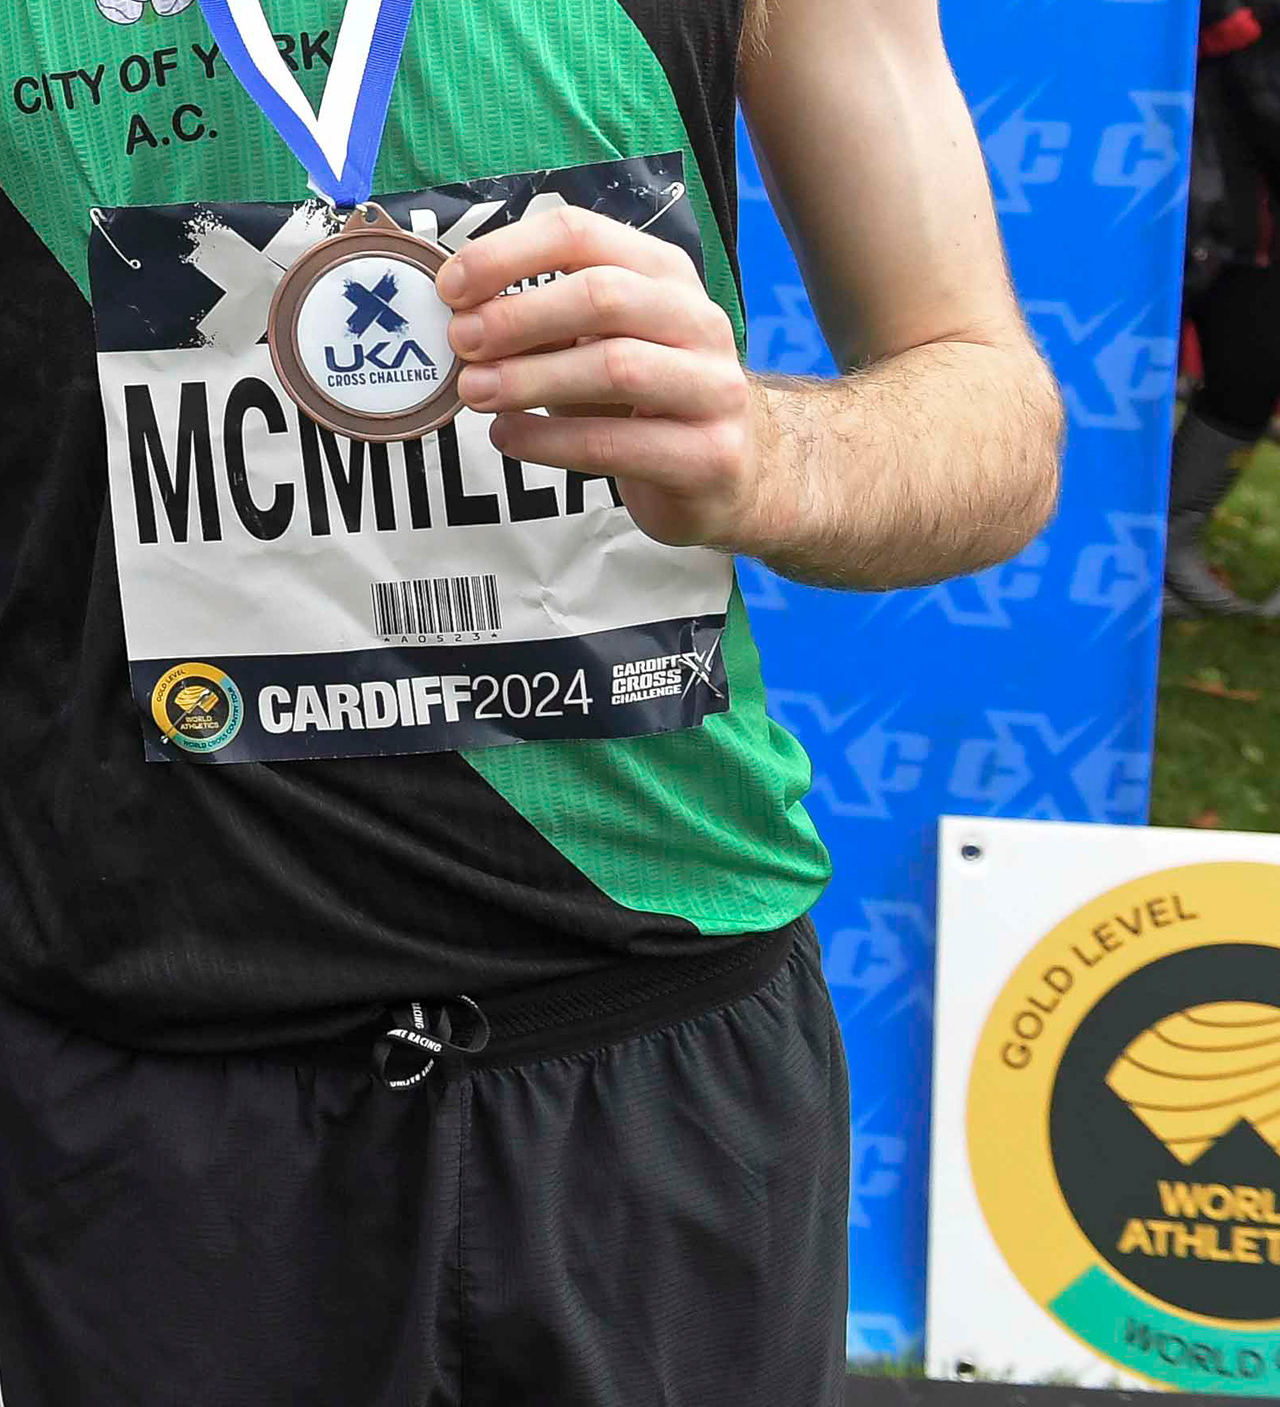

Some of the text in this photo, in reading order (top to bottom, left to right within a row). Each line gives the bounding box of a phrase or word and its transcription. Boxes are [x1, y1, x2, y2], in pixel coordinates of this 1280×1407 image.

[13, 30, 332, 114] CITY OF YRK
[126, 104, 218, 155] A.C.
[324, 340, 435, 372] UKA
[328, 368, 438, 387] CROSS CHALLENGE
[166, 668, 186, 683] LEVEL
[612, 669, 682, 694] CROSS
[611, 684, 682, 705] CHALLENGE
[180, 722, 219, 730] ATHLETICS
[185, 715, 212, 723] WORLD
[1001, 893, 1199, 1070] GOLD LEVEL
[407, 1032, 442, 1052] RACING
[1157, 1179, 1280, 1224] WORL
[1126, 1317, 1266, 1380] WORLD
